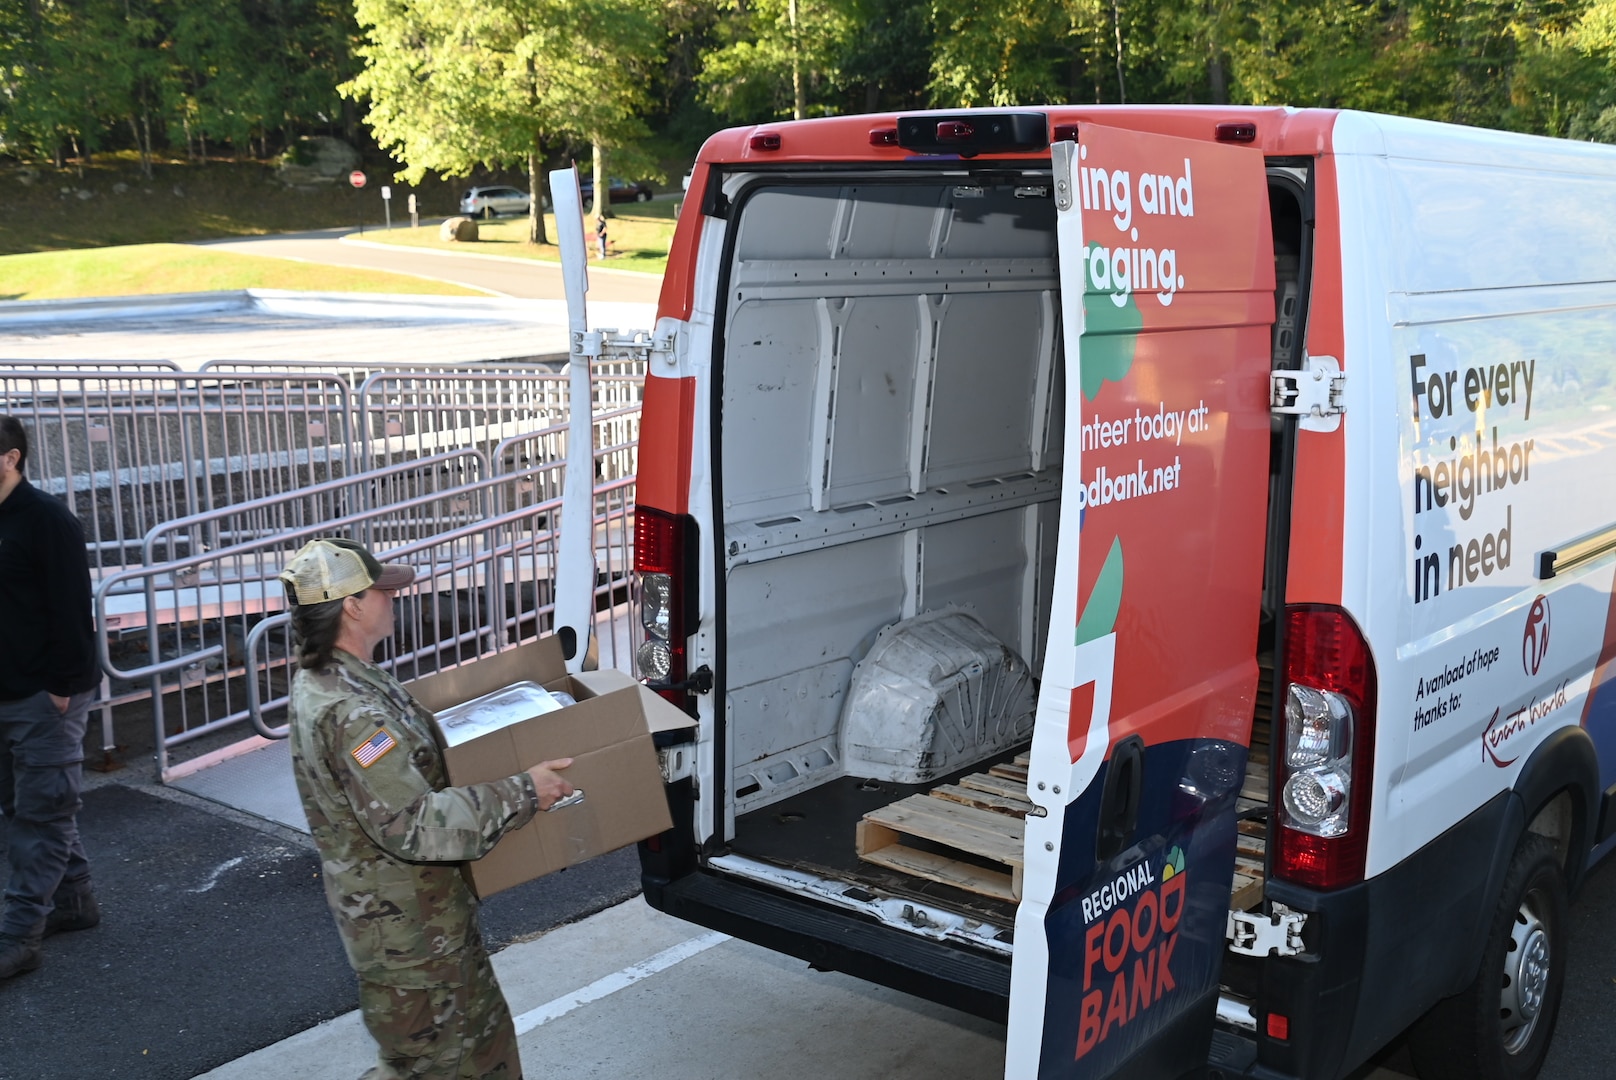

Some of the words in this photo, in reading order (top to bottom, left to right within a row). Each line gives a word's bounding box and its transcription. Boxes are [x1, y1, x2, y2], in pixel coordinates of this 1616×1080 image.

[1081, 144, 1132, 232] ing
[1138, 158, 1194, 217] and
[1081, 413, 1132, 452] nteer
[1134, 400, 1185, 447] today
[1187, 399, 1209, 433] at:
[1410, 353, 1458, 423] For
[1464, 359, 1535, 421] every
[1415, 426, 1535, 521] neighbor
[1415, 534, 1440, 604] in
[1448, 504, 1512, 591] need
[1414, 696, 1447, 732] thanks
[1449, 692, 1462, 714] to:
[1415, 677, 1424, 702] A
[1426, 656, 1466, 697] vanload
[1466, 651, 1478, 676] of
[1477, 647, 1500, 671] hope
[1081, 859, 1155, 925] REGIONAL
[1082, 870, 1187, 993] FOOD
[1074, 931, 1181, 1062] BANK
